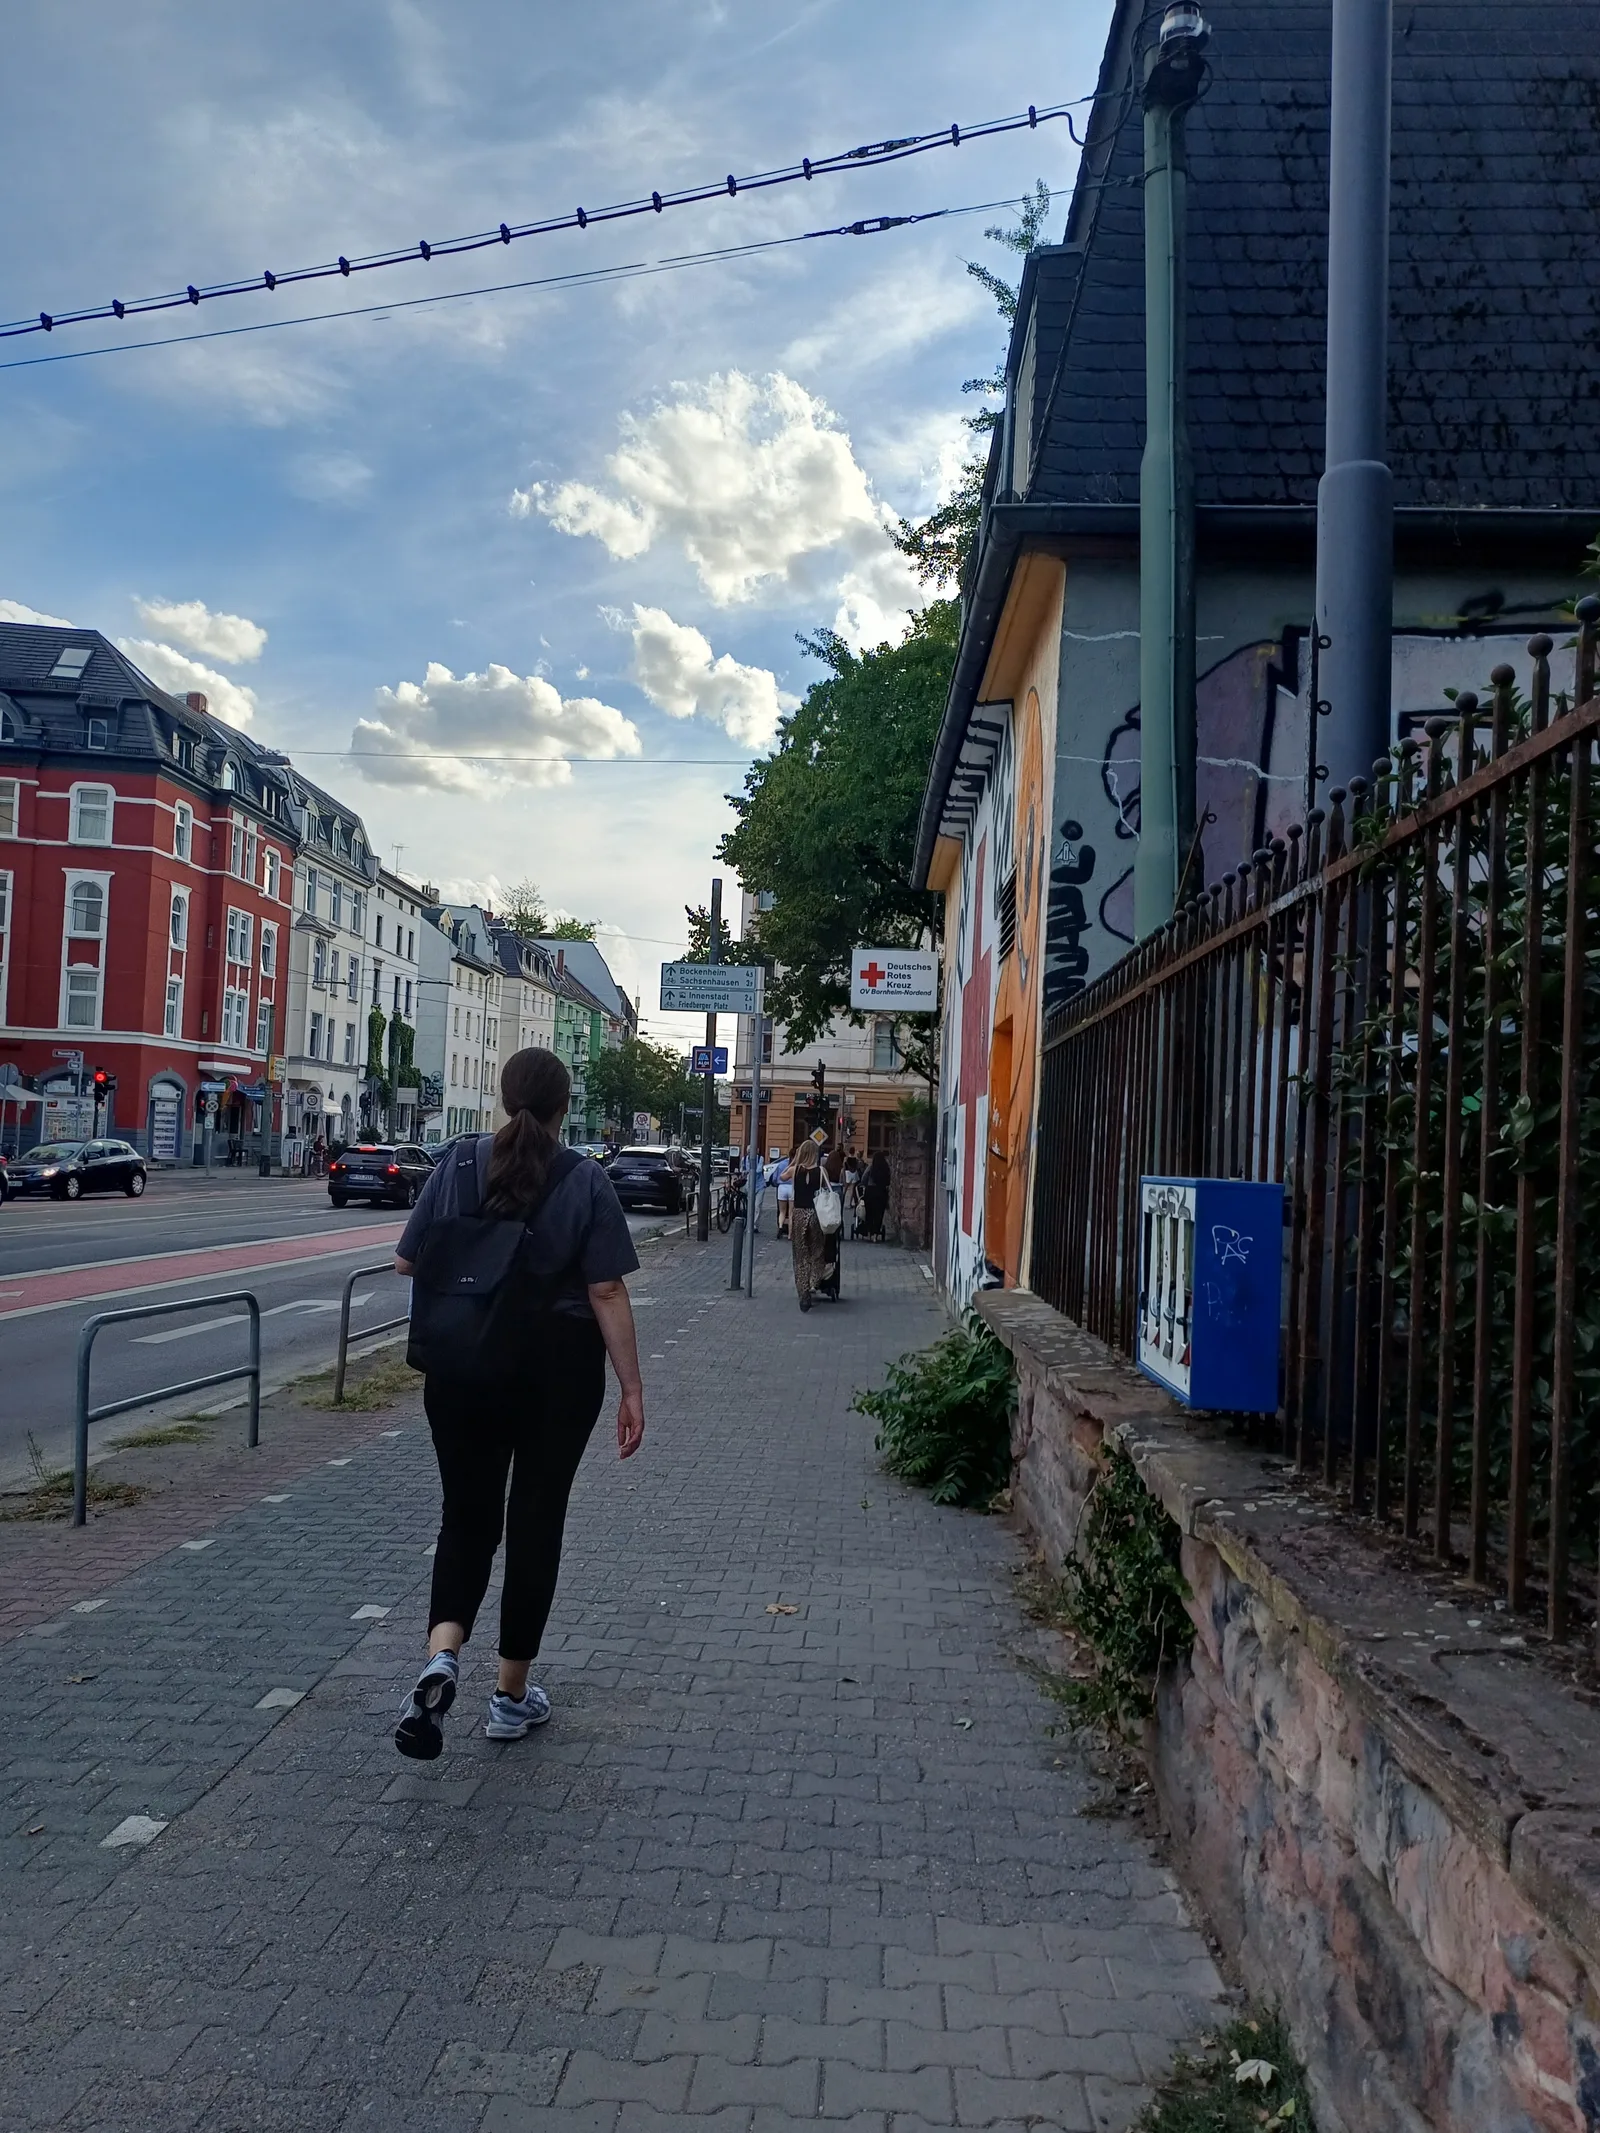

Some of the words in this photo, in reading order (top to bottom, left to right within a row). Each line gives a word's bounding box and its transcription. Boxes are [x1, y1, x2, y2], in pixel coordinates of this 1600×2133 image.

[887, 962, 932, 971] Deutsches
[679, 967, 726, 976] Bockenheim
[887, 972, 912, 980] Rotes
[680, 977, 739, 986] Sachsenhausen
[689, 992, 729, 1000] Innenstadt
[678, 1001, 711, 1010] Friedberger
[713, 1002, 729, 1010] Platz
